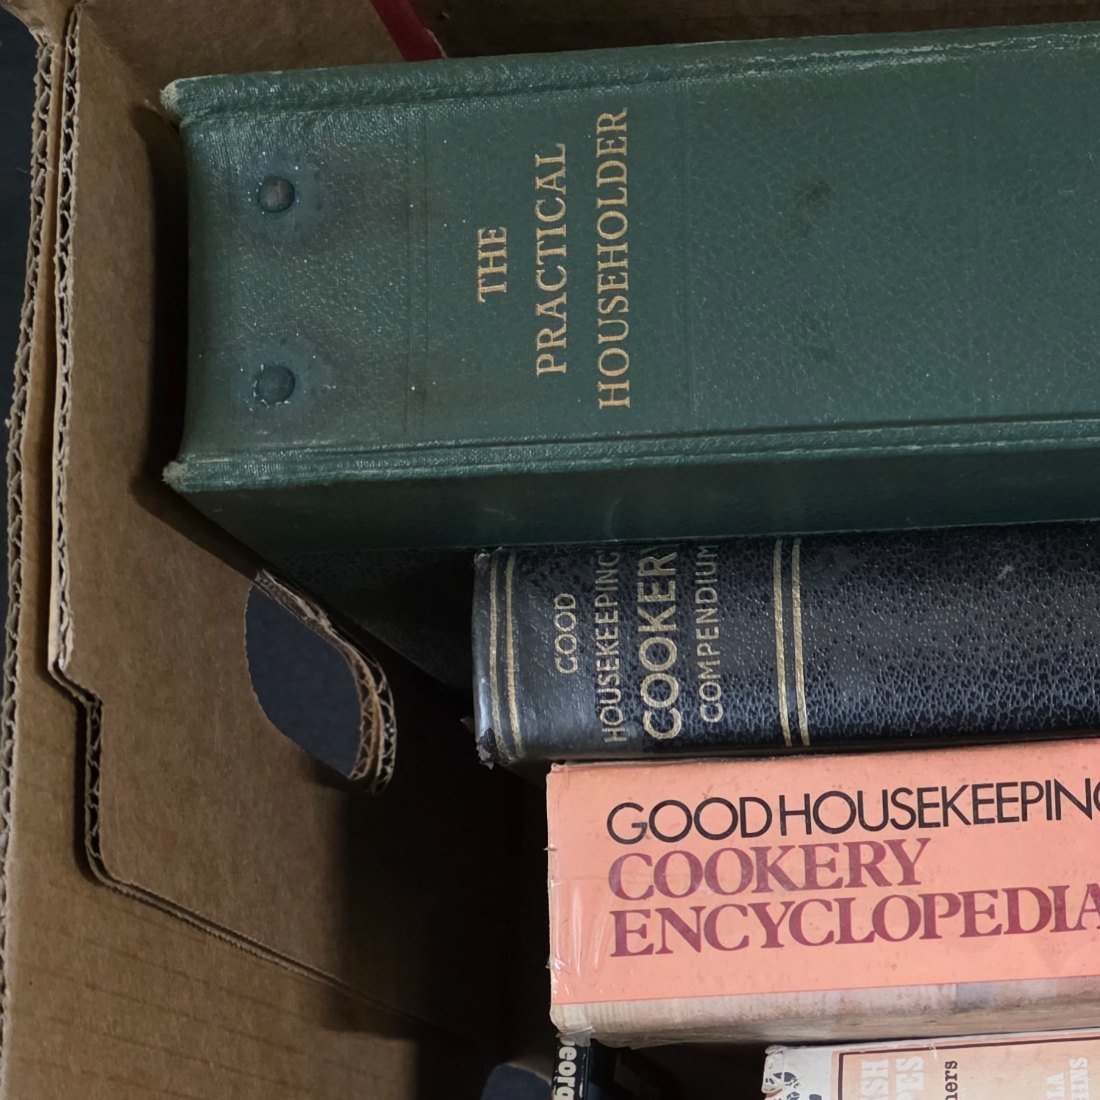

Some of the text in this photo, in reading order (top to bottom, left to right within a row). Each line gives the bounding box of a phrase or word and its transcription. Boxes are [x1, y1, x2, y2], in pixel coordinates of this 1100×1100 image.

[477, 225, 508, 304] THE
[534, 142, 568, 378] PRACTICAL
[596, 106, 631, 410] HOUSEHOLDER
[635, 545, 683, 741] COOKER
[694, 544, 725, 724] COMPENDIUM
[605, 795, 774, 846] GOOD
[607, 836, 932, 903] COOKERY
